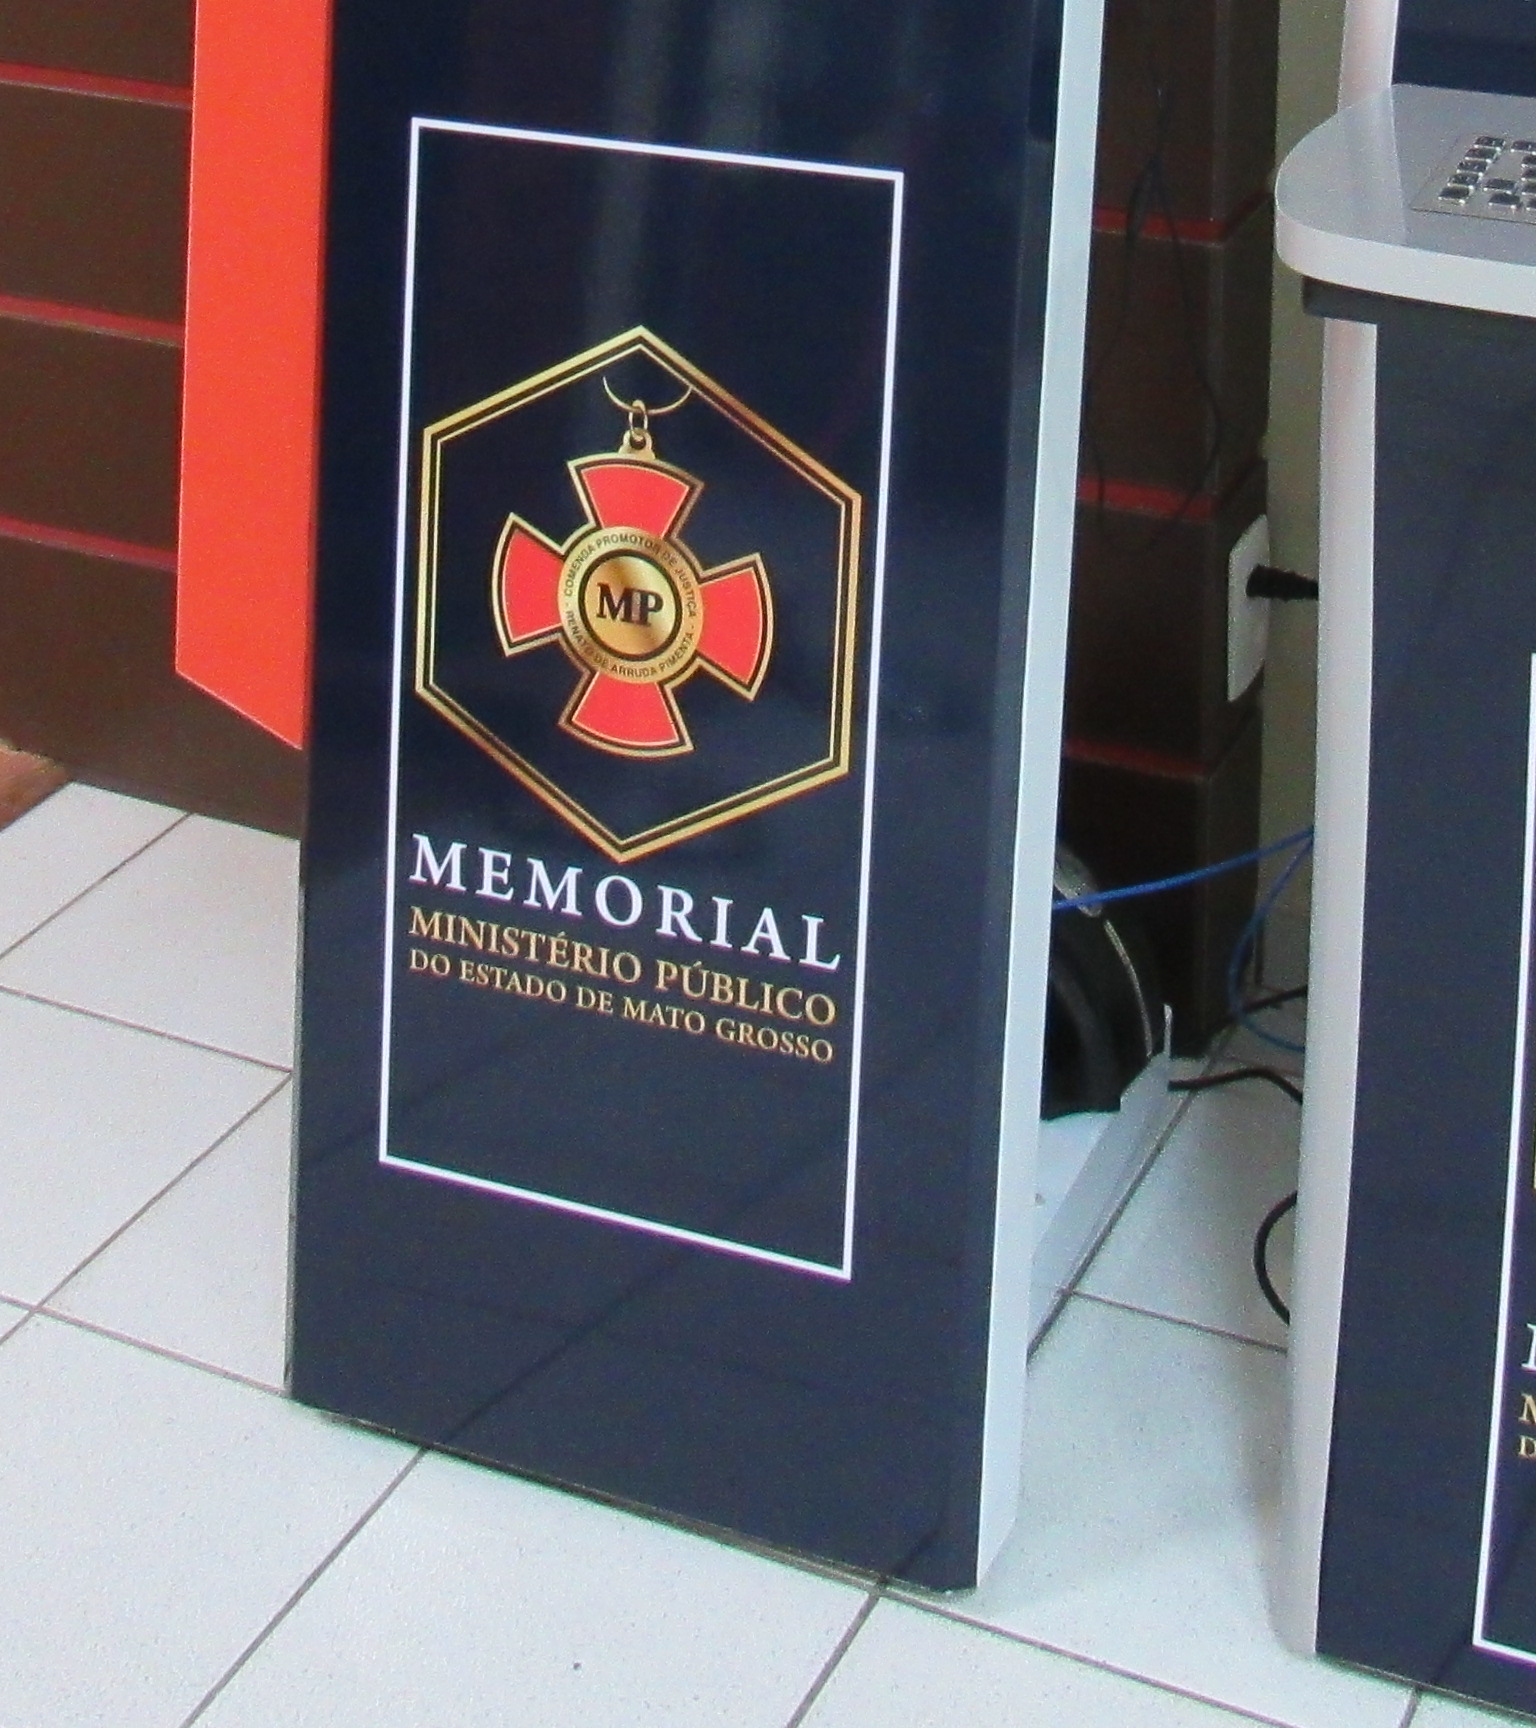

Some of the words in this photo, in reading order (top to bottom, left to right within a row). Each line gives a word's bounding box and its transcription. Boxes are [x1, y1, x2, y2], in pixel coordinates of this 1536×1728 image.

[595, 581, 665, 627] MP
[408, 833, 842, 971] MEMORIAL
[408, 906, 642, 984] MINISTÉRIO
[654, 960, 837, 1026] PÚBLICO
[409, 948, 452, 976] DO
[458, 959, 566, 1003] ESTADO
[575, 986, 615, 1015] DE
[622, 996, 706, 1035] MATO
[715, 1017, 834, 1064] GROSSO
